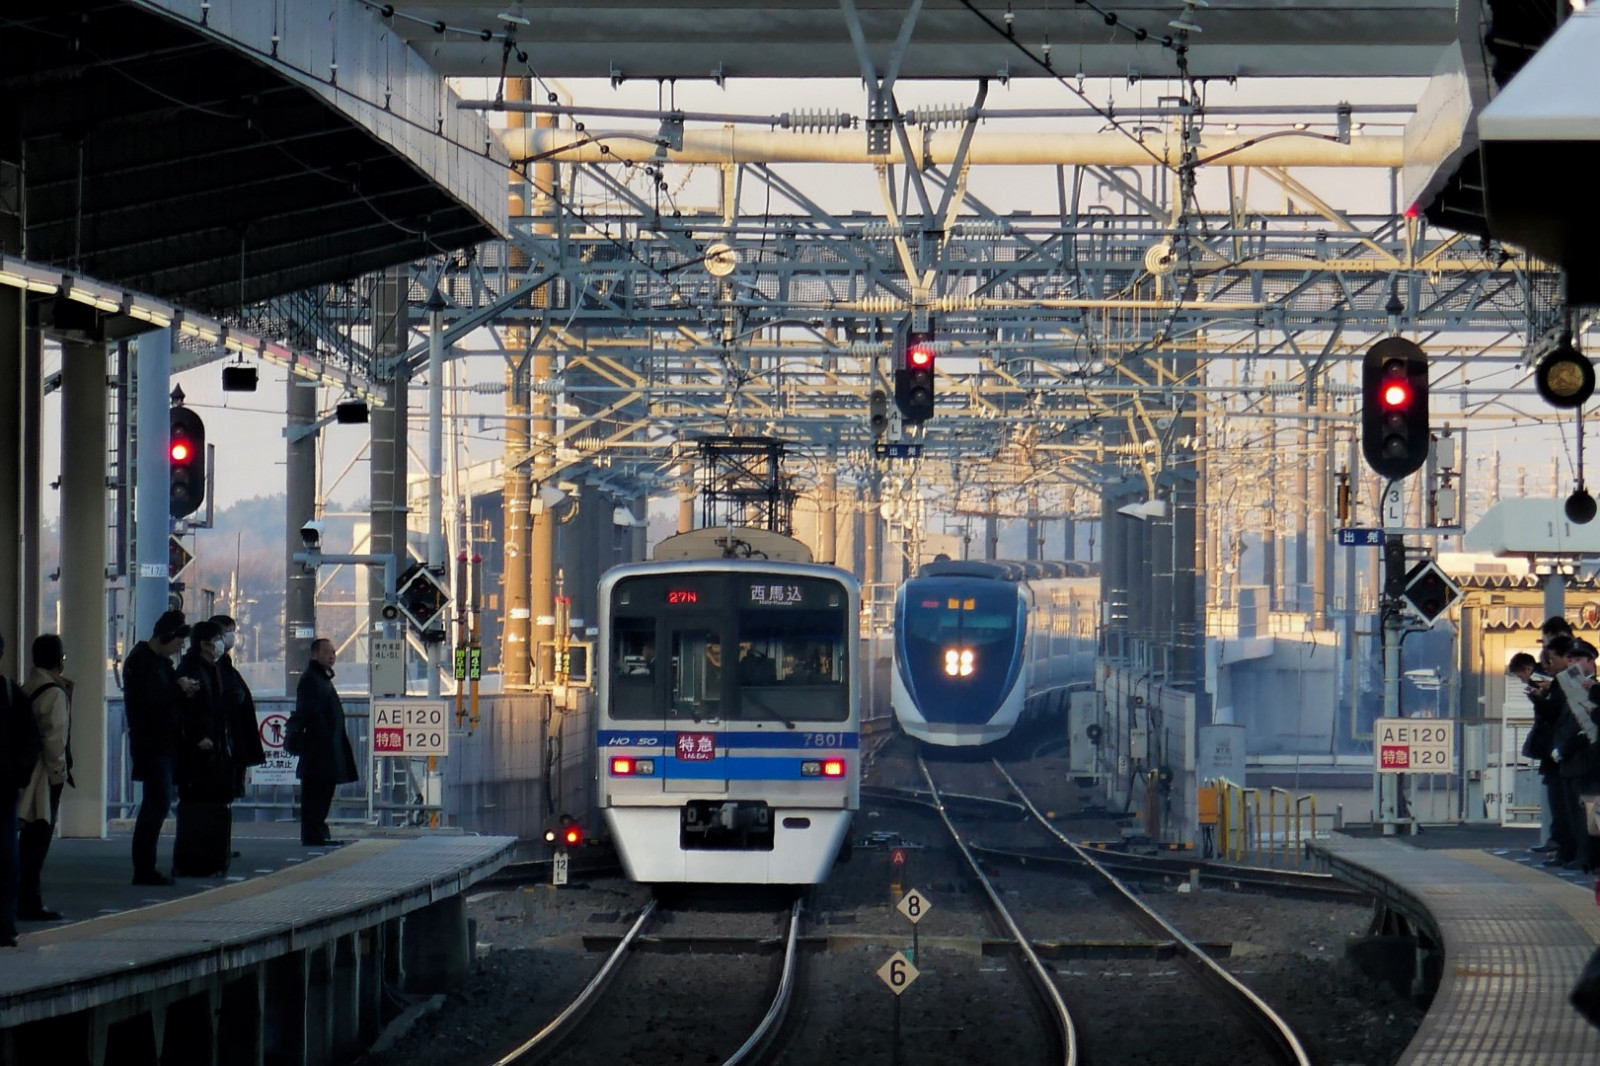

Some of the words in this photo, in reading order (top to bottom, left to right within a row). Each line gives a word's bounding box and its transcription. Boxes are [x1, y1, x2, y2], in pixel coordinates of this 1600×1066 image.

[1343, 530, 1379, 543] 出発
[669, 592, 697, 603] 27N
[750, 585, 802, 601] 西馬込
[376, 709, 401, 724] AE
[406, 710, 441, 724] 120
[376, 732, 402, 747] 特急
[406, 733, 441, 747] 120
[803, 731, 843, 747] 7801
[1383, 728, 1408, 742] AE
[1412, 728, 1446, 742] 120
[679, 735, 713, 752] 特急
[1382, 750, 1408, 765] 特急
[1412, 751, 1446, 764] 120
[555, 859, 567, 870] 12
[893, 852, 904, 863] A
[908, 895, 921, 916] 8
[890, 959, 906, 987] 6
